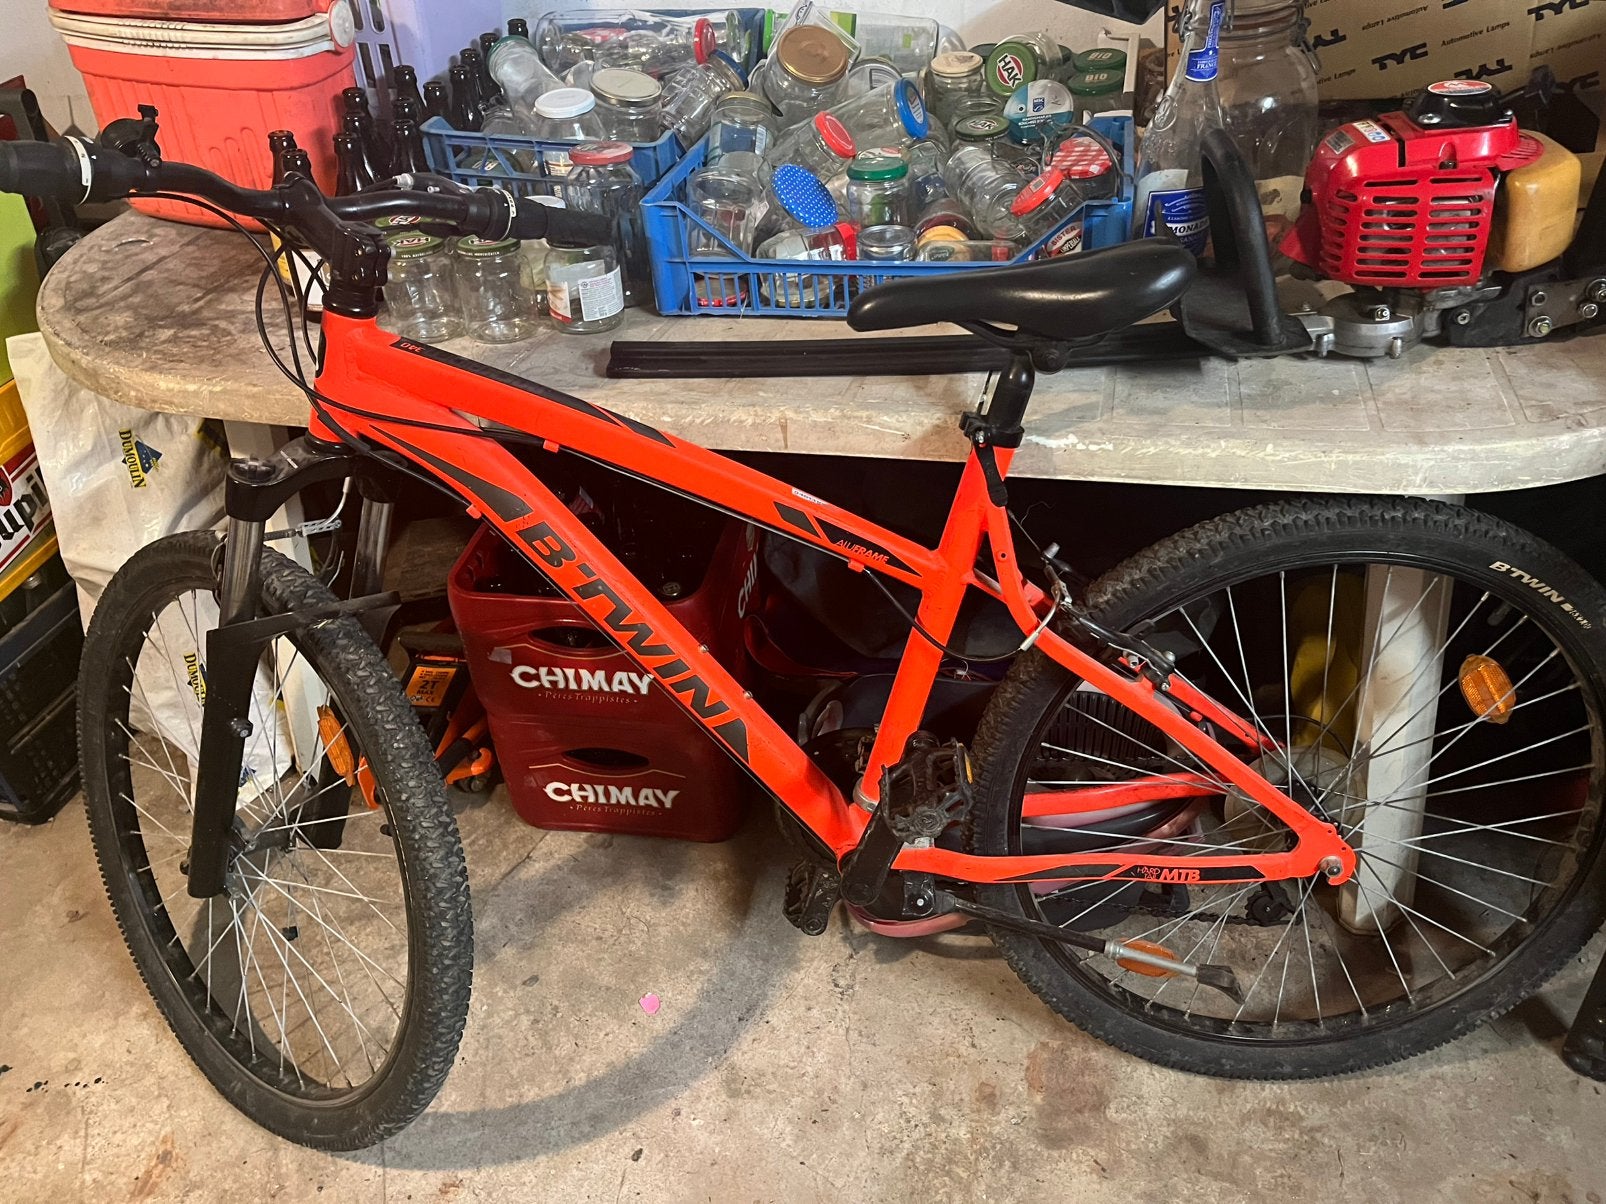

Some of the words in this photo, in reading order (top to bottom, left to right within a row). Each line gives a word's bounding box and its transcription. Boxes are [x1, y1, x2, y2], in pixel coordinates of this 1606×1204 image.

[1441, 29, 1484, 47] Automotive
[1486, 21, 1510, 33] Lamps
[1371, 42, 1429, 71] TYC
[998, 54, 1022, 87] HAK
[1051, 225, 1077, 246] BISTER
[119, 429, 147, 488] DUMOULIN
[419, 680, 440, 690] 2T
[509, 665, 655, 696] CHIMAY
[574, 692, 631, 704] Trappistes
[543, 781, 681, 809] CHIMAY
[1160, 868, 1201, 881] MTB
